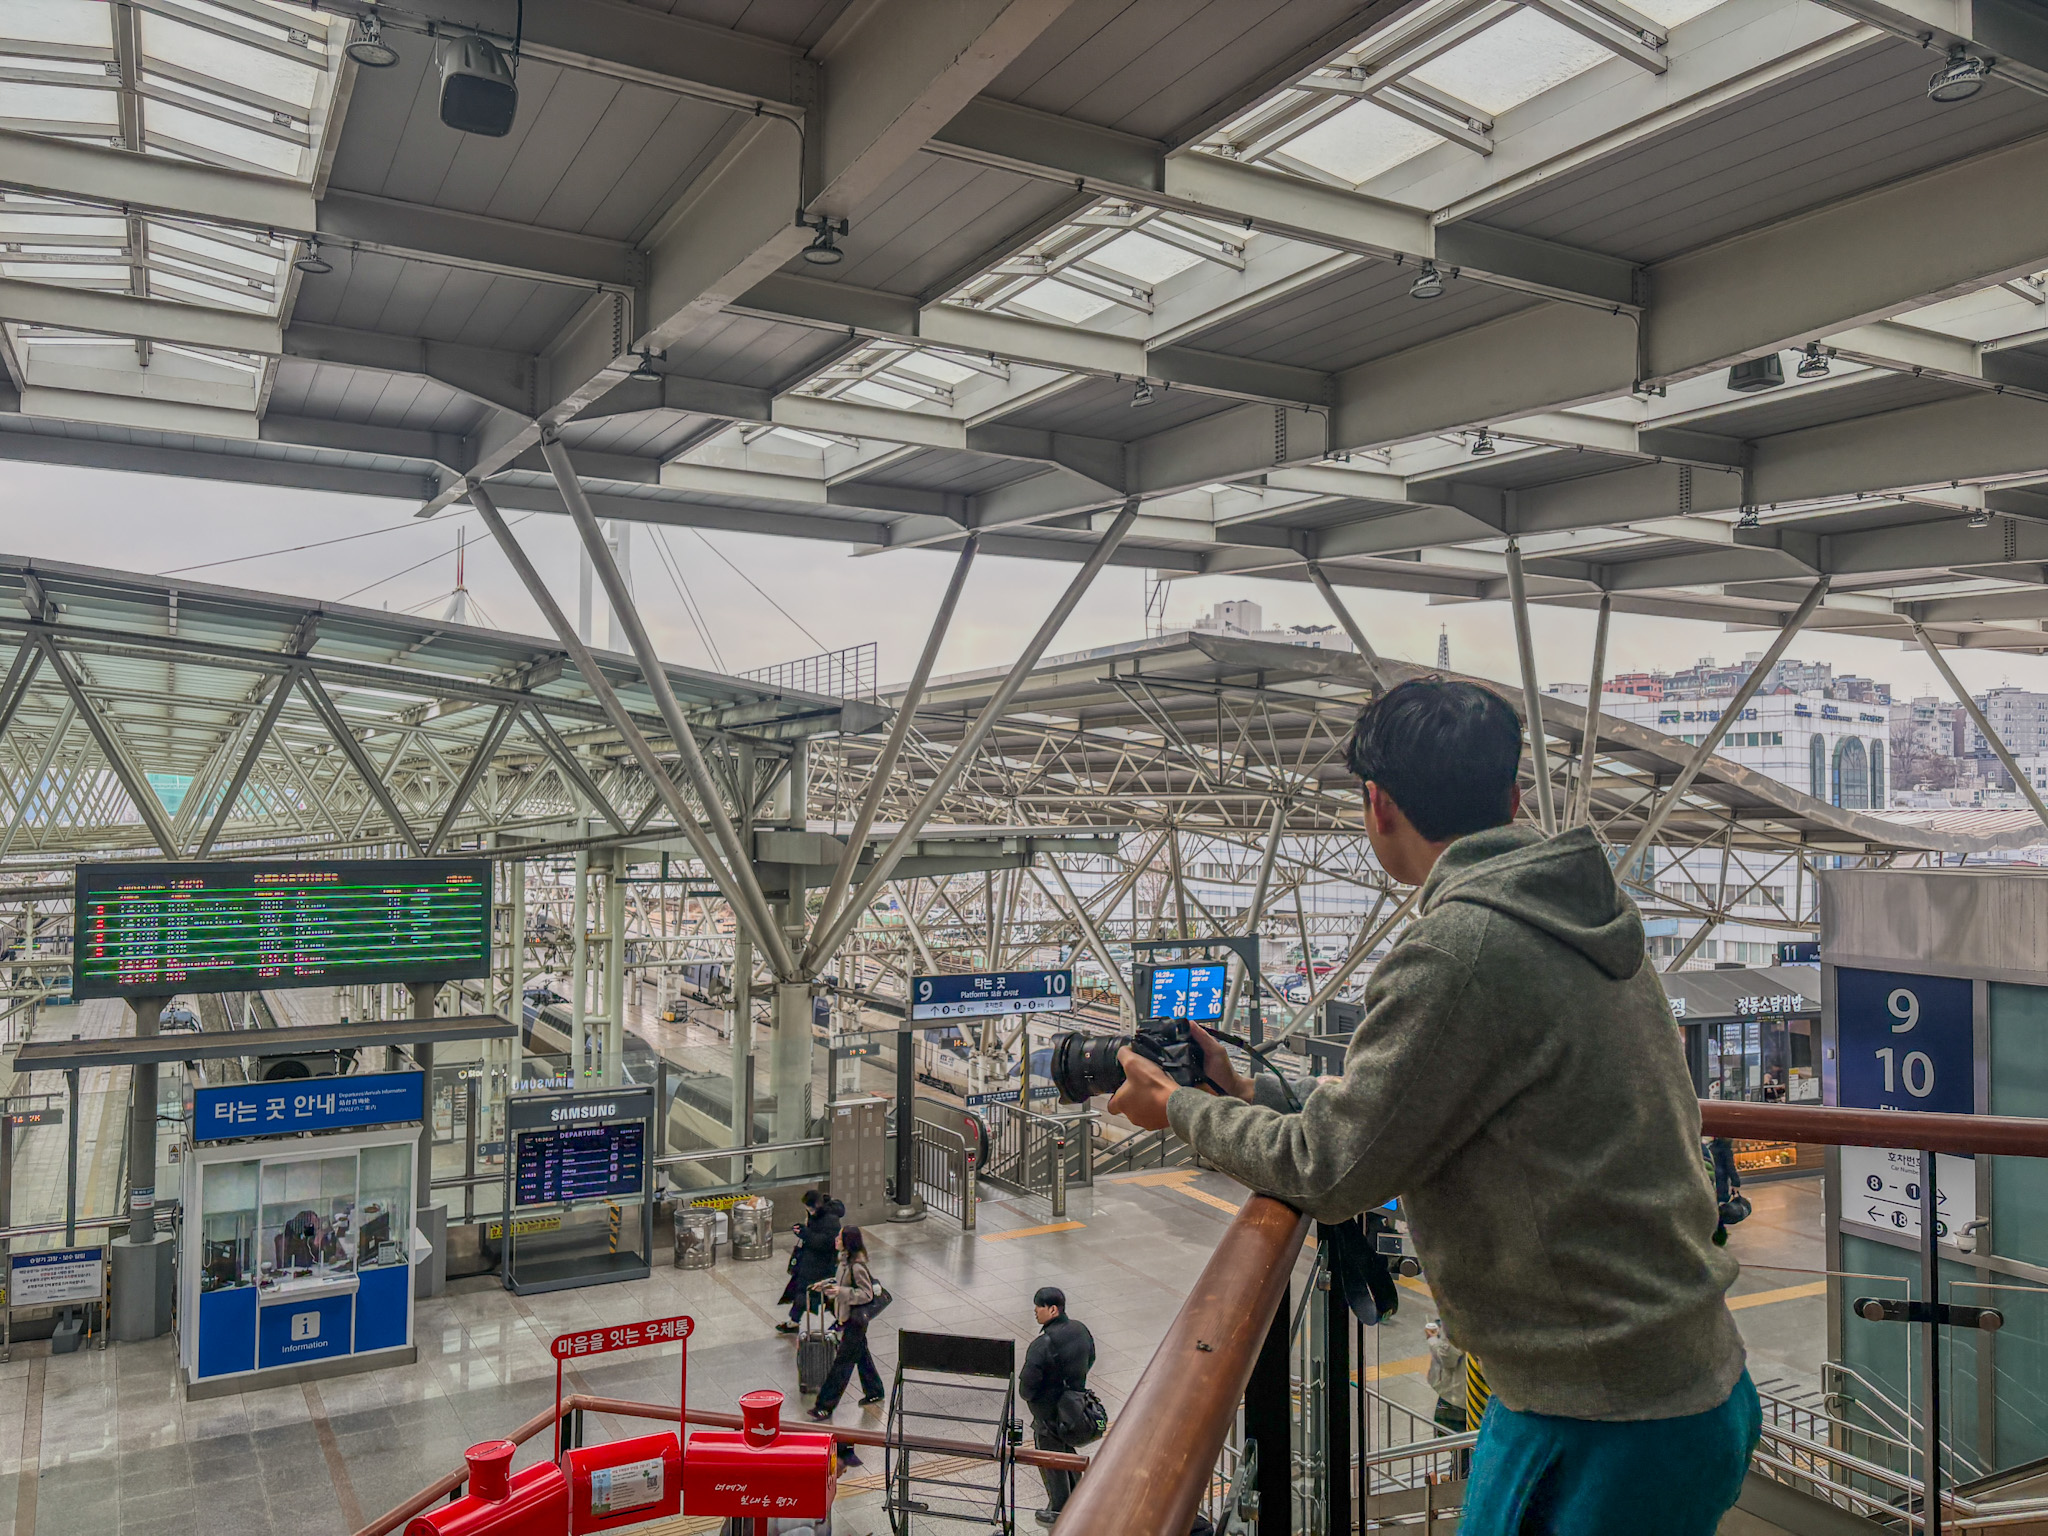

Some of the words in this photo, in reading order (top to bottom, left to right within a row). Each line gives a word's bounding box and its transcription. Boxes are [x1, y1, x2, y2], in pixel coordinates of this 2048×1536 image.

[1784, 944, 1797, 961] 11
[919, 980, 933, 1002] 9
[974, 977, 993, 991] 타는
[996, 976, 1006, 990] 곳
[1043, 974, 1066, 995] 10
[960, 990, 989, 999] Platforms
[1172, 1004, 1186, 1017] 10
[1208, 1002, 1221, 1015] 10
[1737, 994, 1804, 1016] 정동소담김밥
[1887, 988, 1920, 1034] 9
[1875, 1046, 1935, 1098] 10
[214, 1101, 257, 1124] 타는
[266, 1097, 286, 1121] 곳
[293, 1092, 336, 1118] 안내
[551, 1104, 616, 1122] SAMSUNG
[560, 1129, 605, 1139] DEPARTURES
[480, 1146, 487, 1154] 9
[1900, 1166, 1920, 1175] Numbe
[557, 1333, 604, 1357] 마음을
[610, 1327, 640, 1349] 잇는
[644, 1317, 690, 1342] 우체통
[281, 1340, 329, 1353] Information
[714, 1483, 747, 1492] 너에게
[741, 1495, 771, 1507] 보내는
[776, 1496, 798, 1508] 편지
